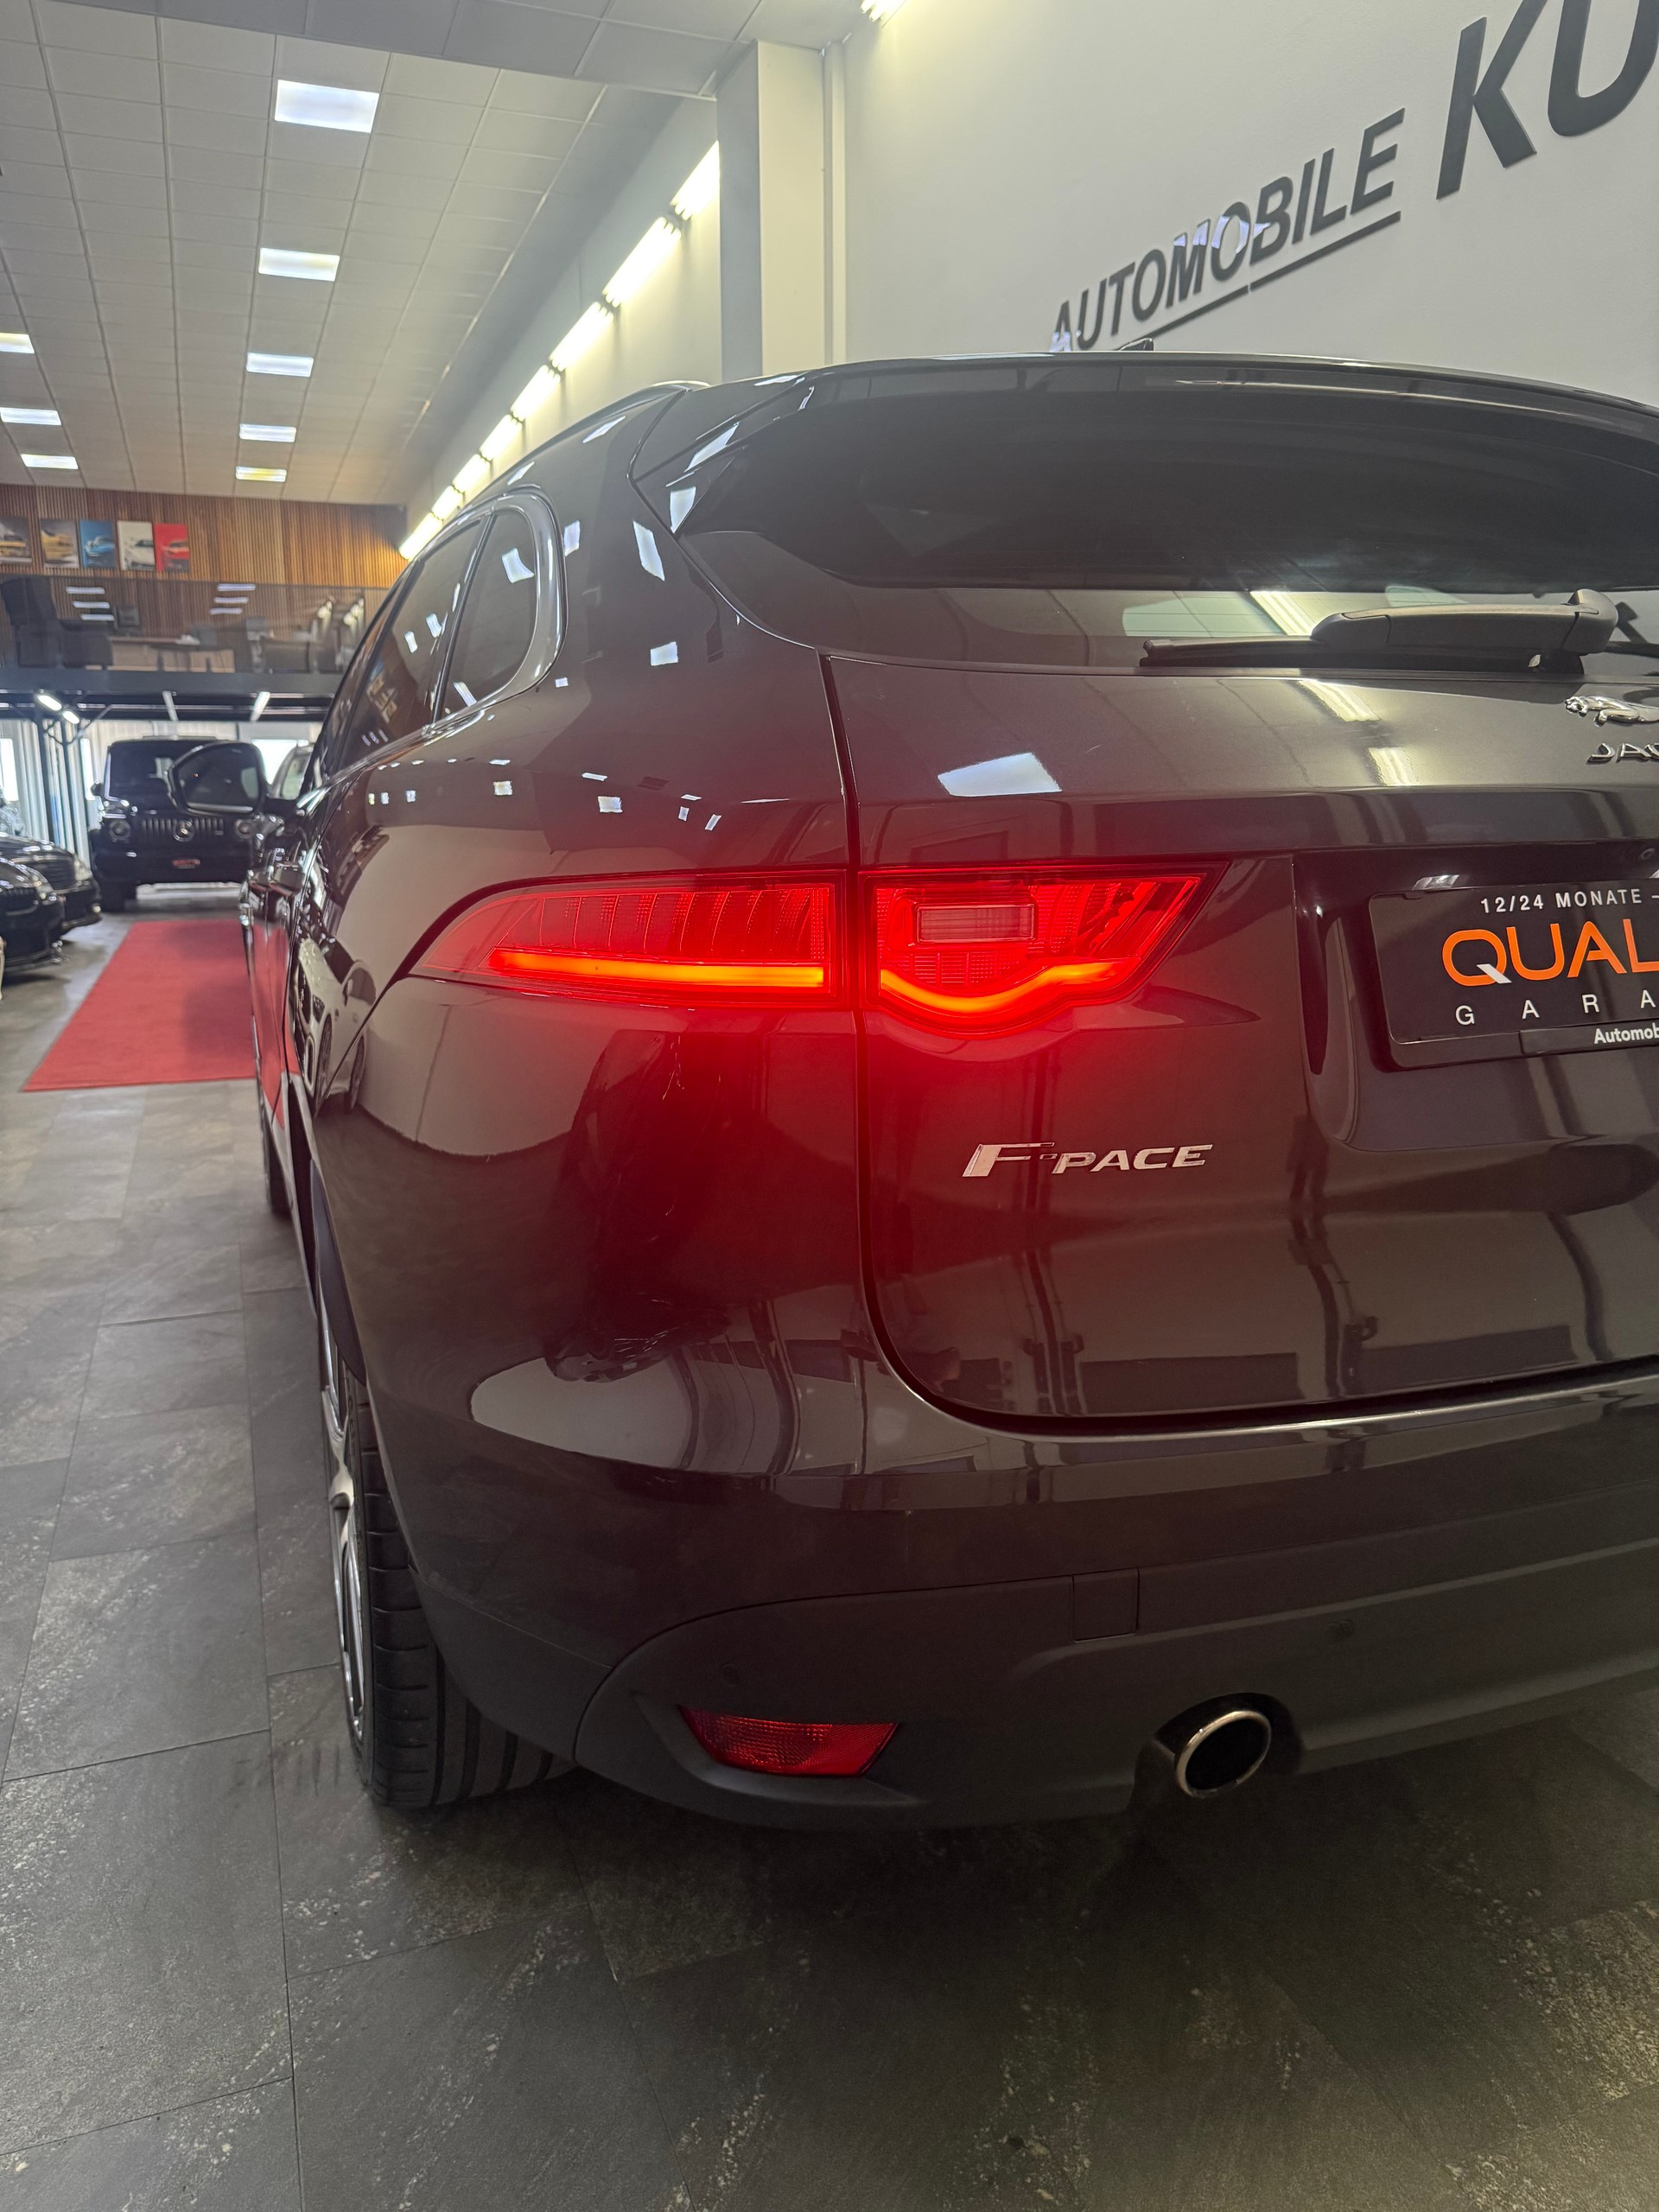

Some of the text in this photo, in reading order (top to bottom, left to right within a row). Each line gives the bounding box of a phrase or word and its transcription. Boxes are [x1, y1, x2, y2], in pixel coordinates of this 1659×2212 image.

[1049, 107, 1405, 353] AUTOMOBILE
[1480, 888, 1642, 913] 12/24 MONATE
[1442, 918, 1659, 987] QUAL
[1455, 989, 1656, 1026] GARA
[962, 1141, 1213, 1178] F-PACE
